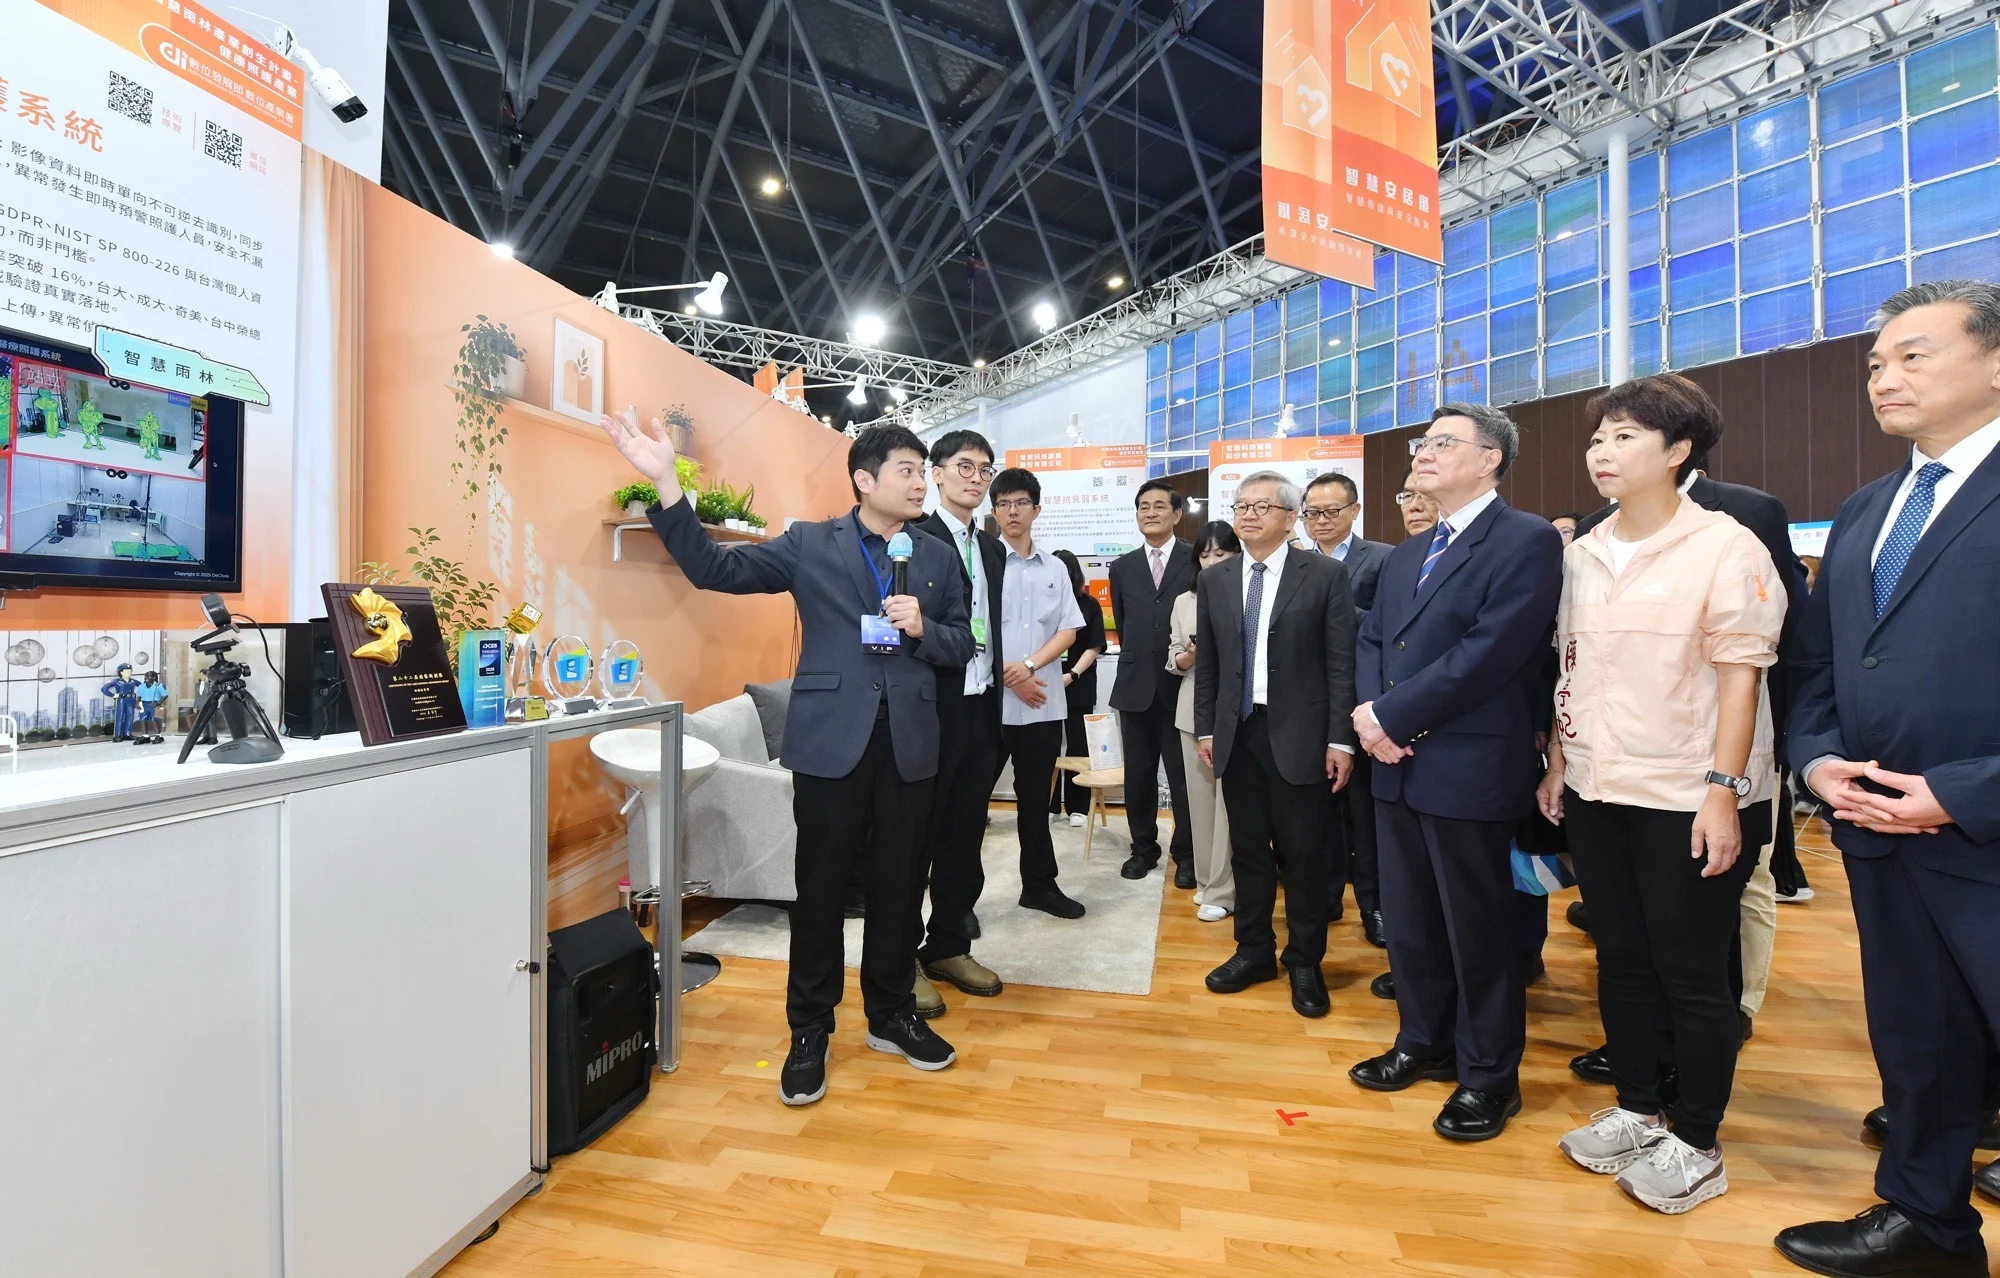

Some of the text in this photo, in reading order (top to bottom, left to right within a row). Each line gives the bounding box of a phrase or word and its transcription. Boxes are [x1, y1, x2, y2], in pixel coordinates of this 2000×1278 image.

[0, 76, 104, 153] 系統
[0, 161, 263, 269] ，異常發生即時預警照護人員，安全不漏
[0, 270, 118, 314] 驗證真實落地。
[98, 239, 118, 252] SP
[122, 248, 180, 276] 800-226
[184, 268, 262, 305] 與台灣個人資
[124, 350, 214, 385] 智慧雨林
[1040, 495, 1109, 505] 智慧抗衰弱系統
